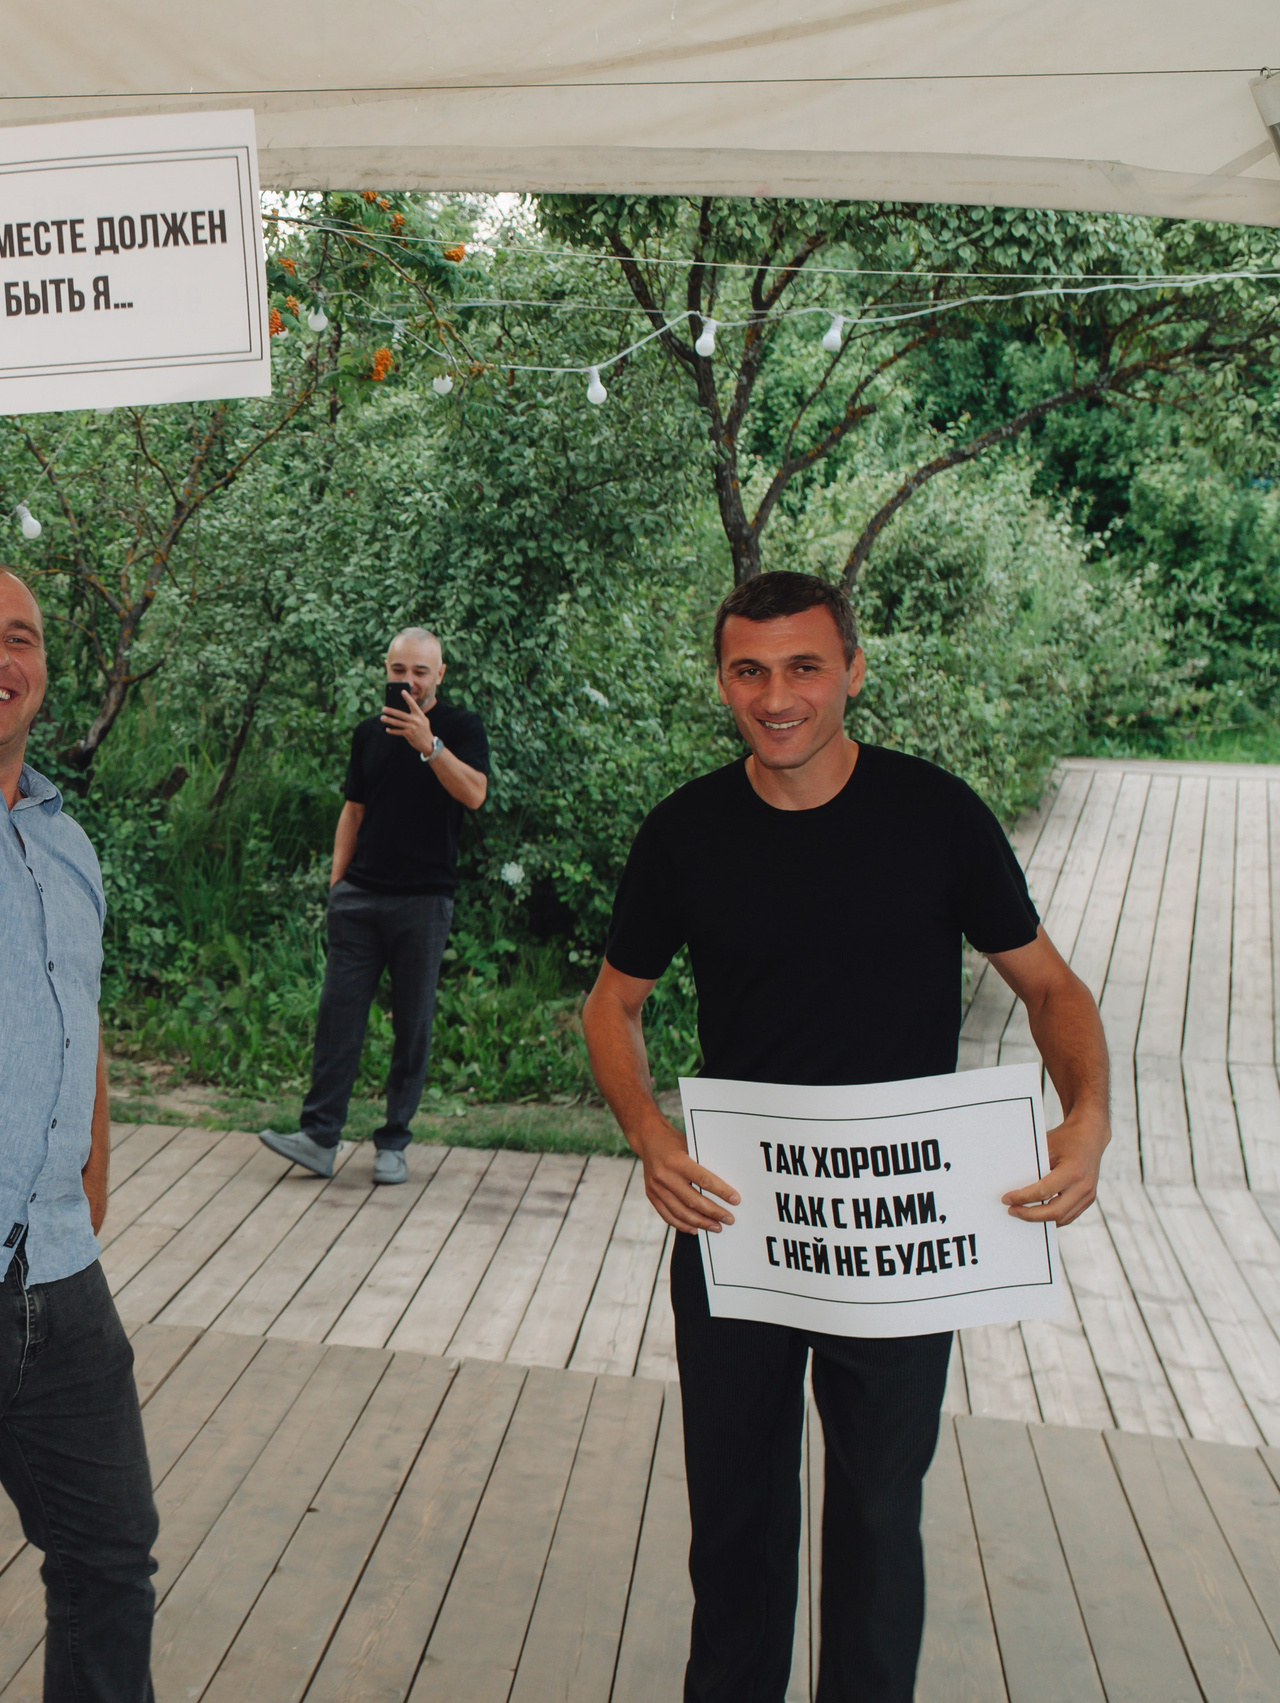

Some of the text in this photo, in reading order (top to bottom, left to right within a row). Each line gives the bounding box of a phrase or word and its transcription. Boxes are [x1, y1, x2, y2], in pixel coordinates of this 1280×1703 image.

[94, 209, 227, 256] ДОЛЖЕН
[4, 275, 134, 317] БЫТЬ Я...
[759, 1138, 952, 1179] ТАК ХОРОШО,
[775, 1191, 947, 1230] КАК С НАМИ,
[765, 1233, 979, 1277] С НЕЙ НЕ БУДЕТ!
